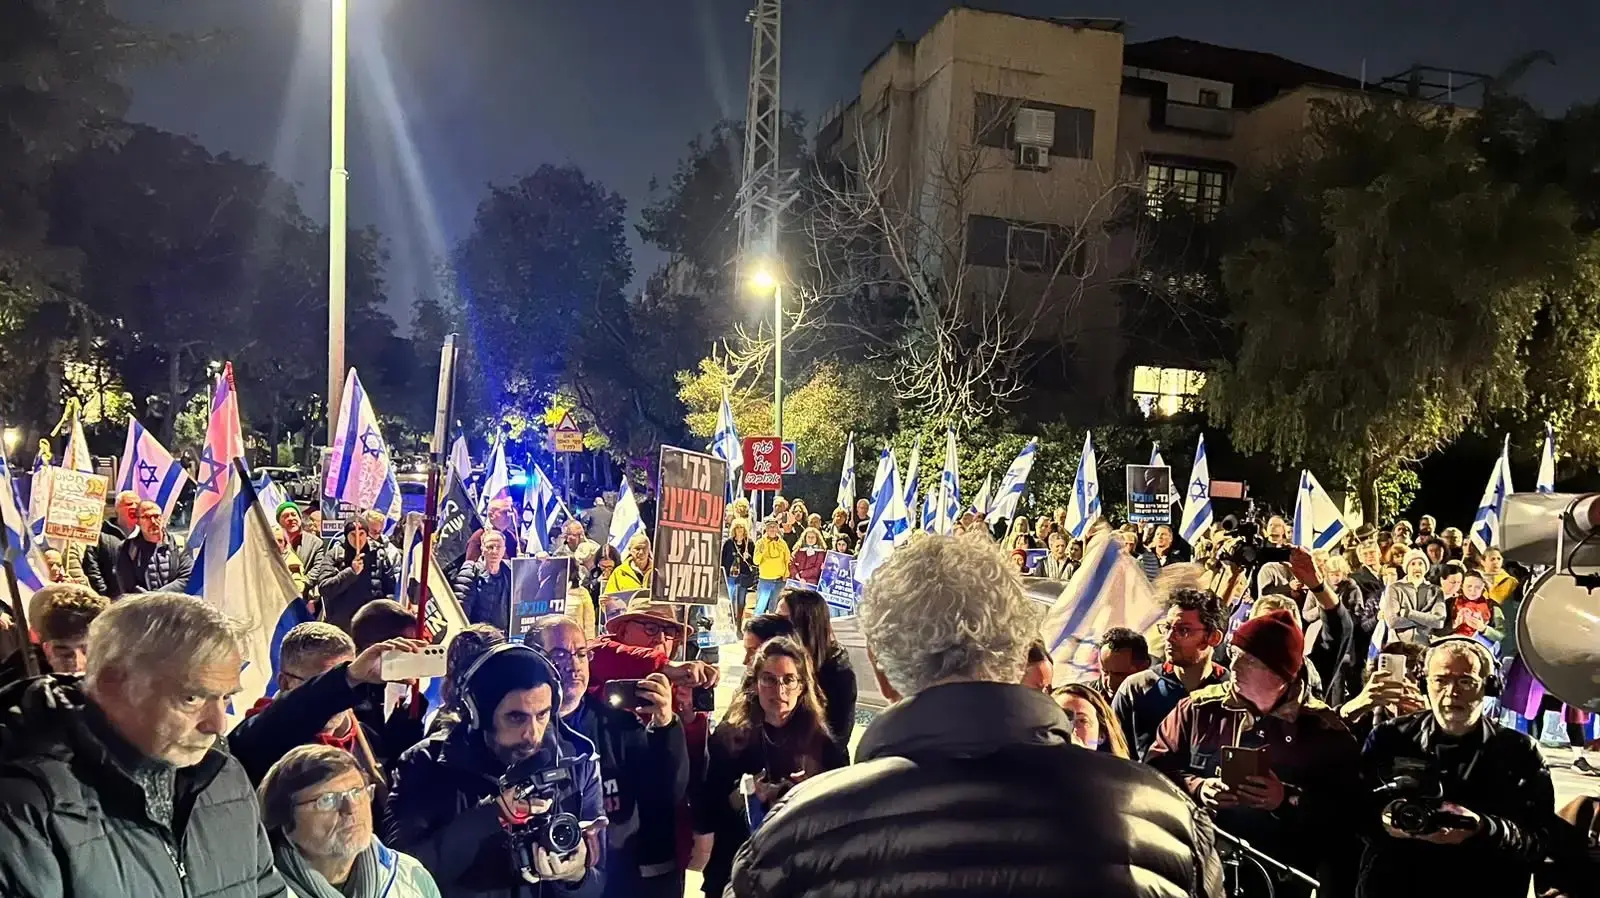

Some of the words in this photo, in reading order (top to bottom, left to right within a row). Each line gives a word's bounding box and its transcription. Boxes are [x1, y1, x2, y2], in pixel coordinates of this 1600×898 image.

[682, 453, 711, 491] גדי
[754, 455, 772, 472] ארץ
[662, 486, 724, 529] עכשיו!
[668, 529, 713, 565] הגיע
[664, 562, 715, 602] הזמן!
[549, 598, 565, 612] גדי
